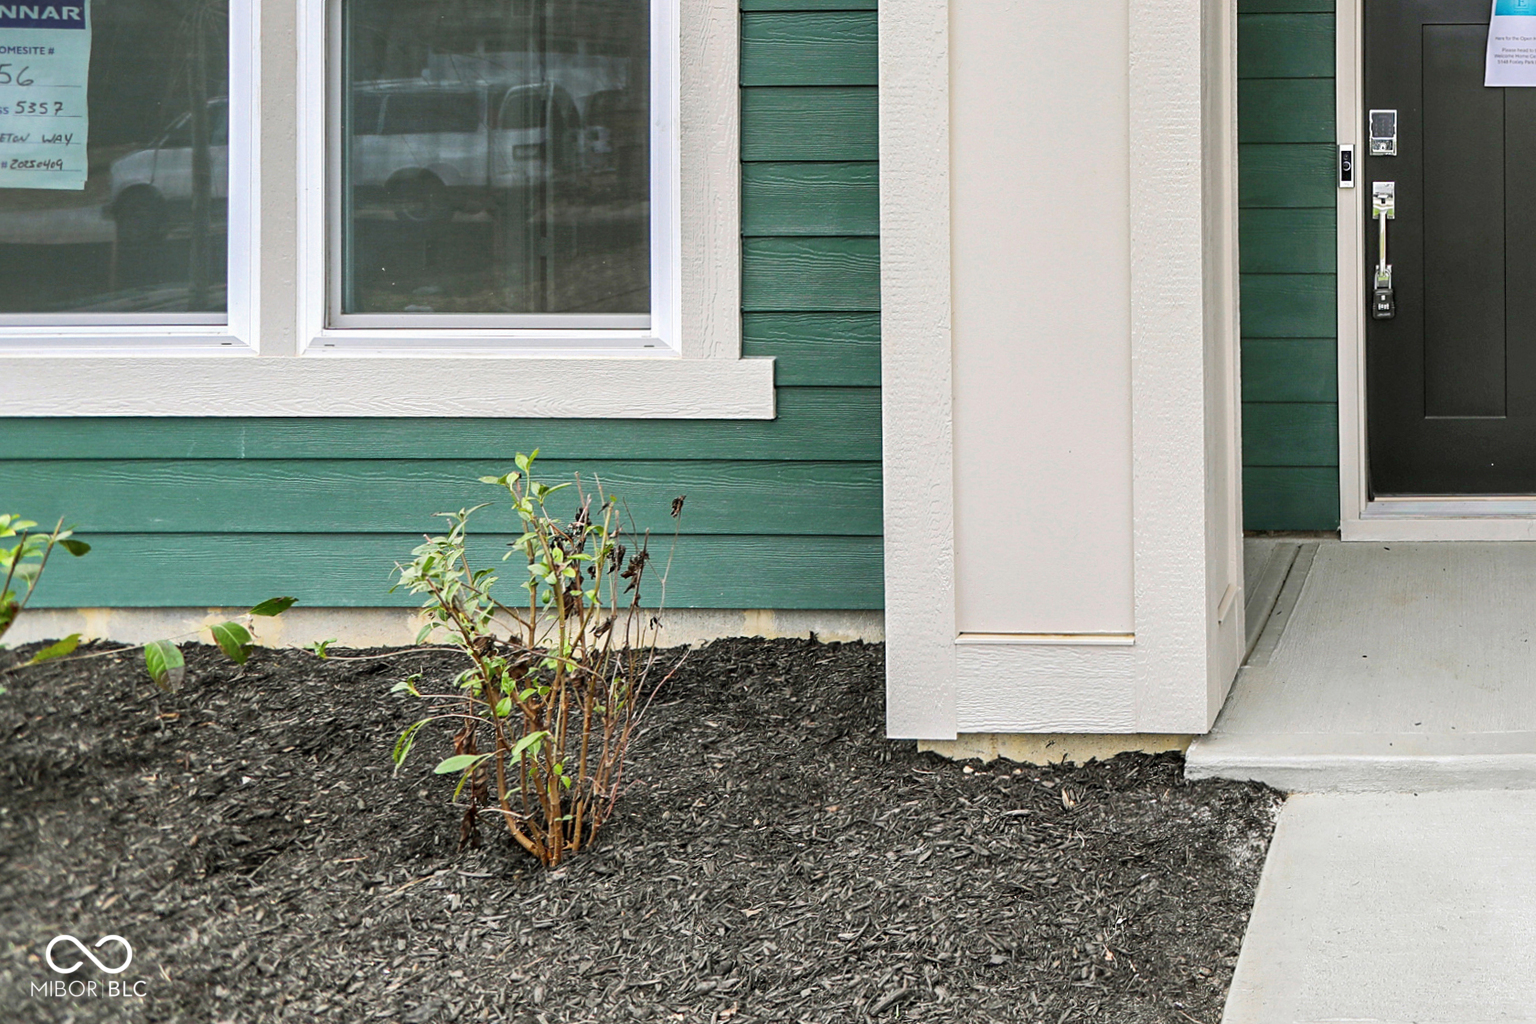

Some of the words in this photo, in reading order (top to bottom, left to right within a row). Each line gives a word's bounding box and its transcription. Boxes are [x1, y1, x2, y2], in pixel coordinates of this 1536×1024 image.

[48, 47, 55, 56] #
[15, 100, 64, 116] 5357
[42, 132, 74, 146] WAY
[10, 158, 64, 171] 20250409
